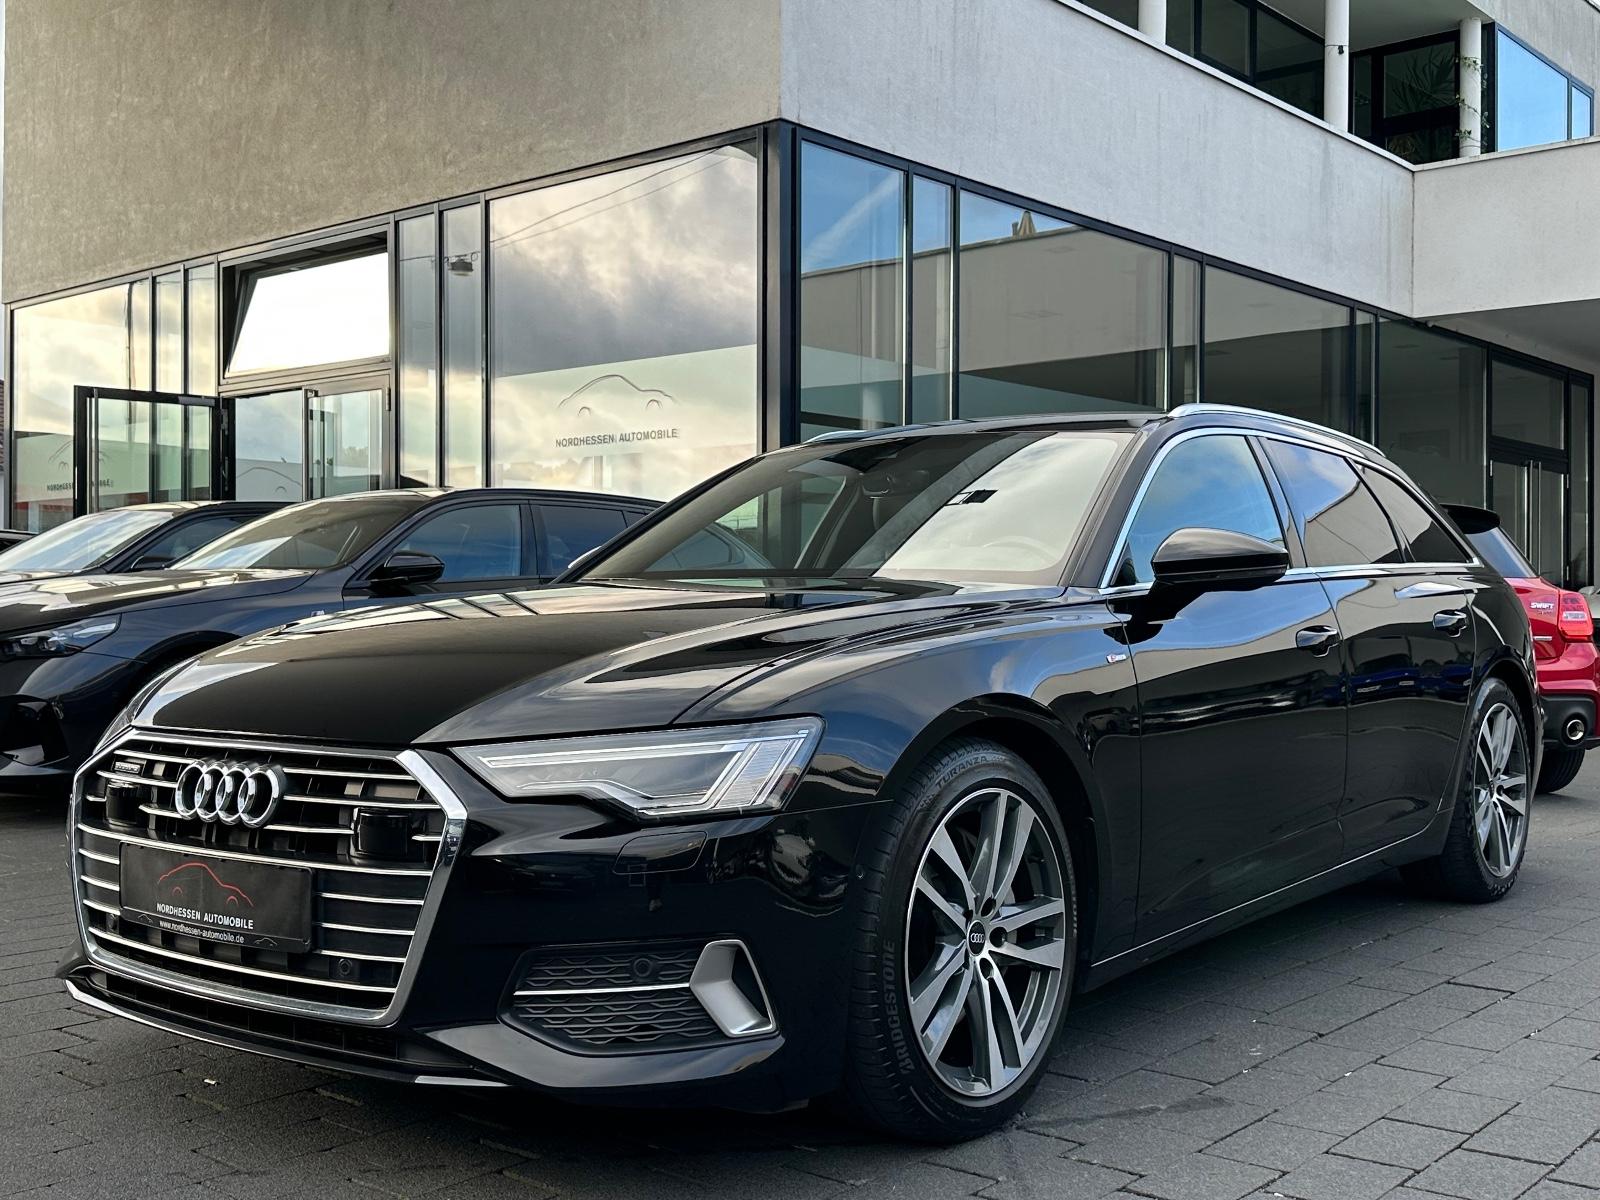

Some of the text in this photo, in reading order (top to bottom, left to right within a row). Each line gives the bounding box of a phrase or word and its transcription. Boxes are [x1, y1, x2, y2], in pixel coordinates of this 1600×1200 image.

[555, 428, 678, 448] NORDHESSEN AUTOMOBILE
[935, 756, 988, 788] TURANZA
[157, 903, 253, 930] NORDHESSEN AUTOMOBILE
[159, 920, 245, 943] www.nordhessen-automobile.de
[883, 941, 914, 1074] BRIDGESTONE
